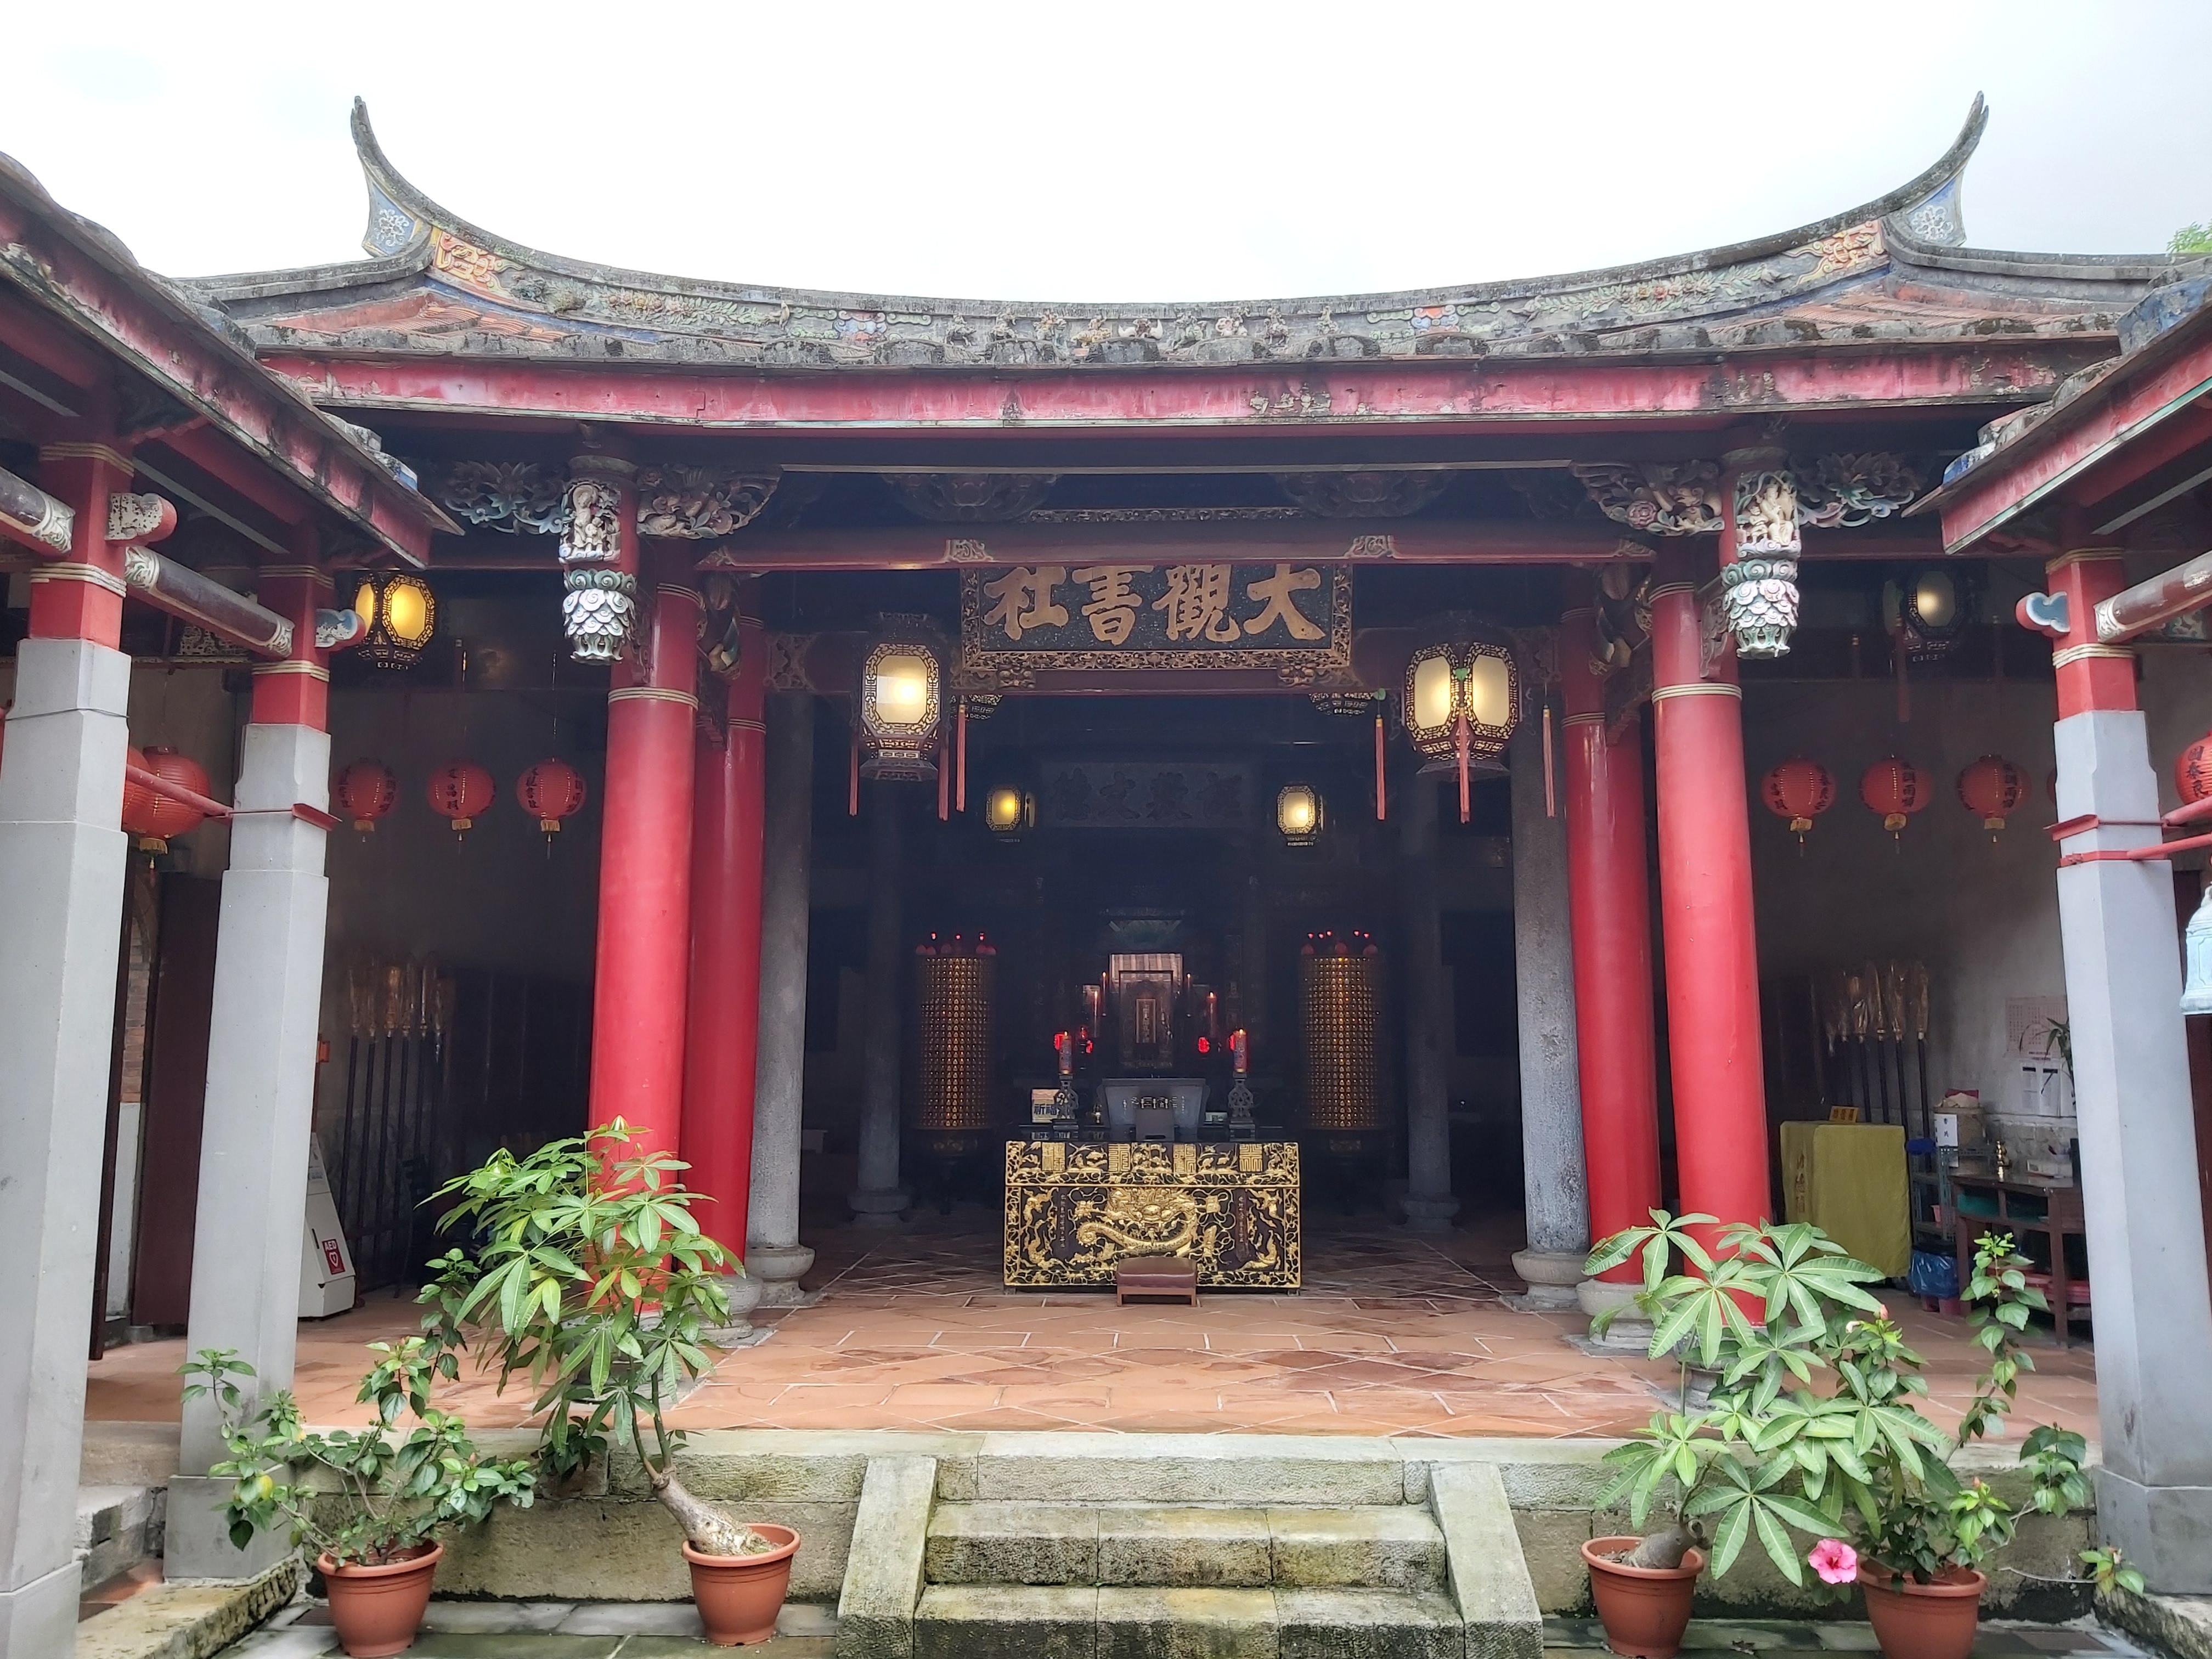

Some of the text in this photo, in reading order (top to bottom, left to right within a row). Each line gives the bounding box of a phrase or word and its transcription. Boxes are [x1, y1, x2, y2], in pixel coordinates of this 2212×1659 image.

[2186, 746, 2209, 799] 國泰民
[324, 1240, 337, 1251] AED
